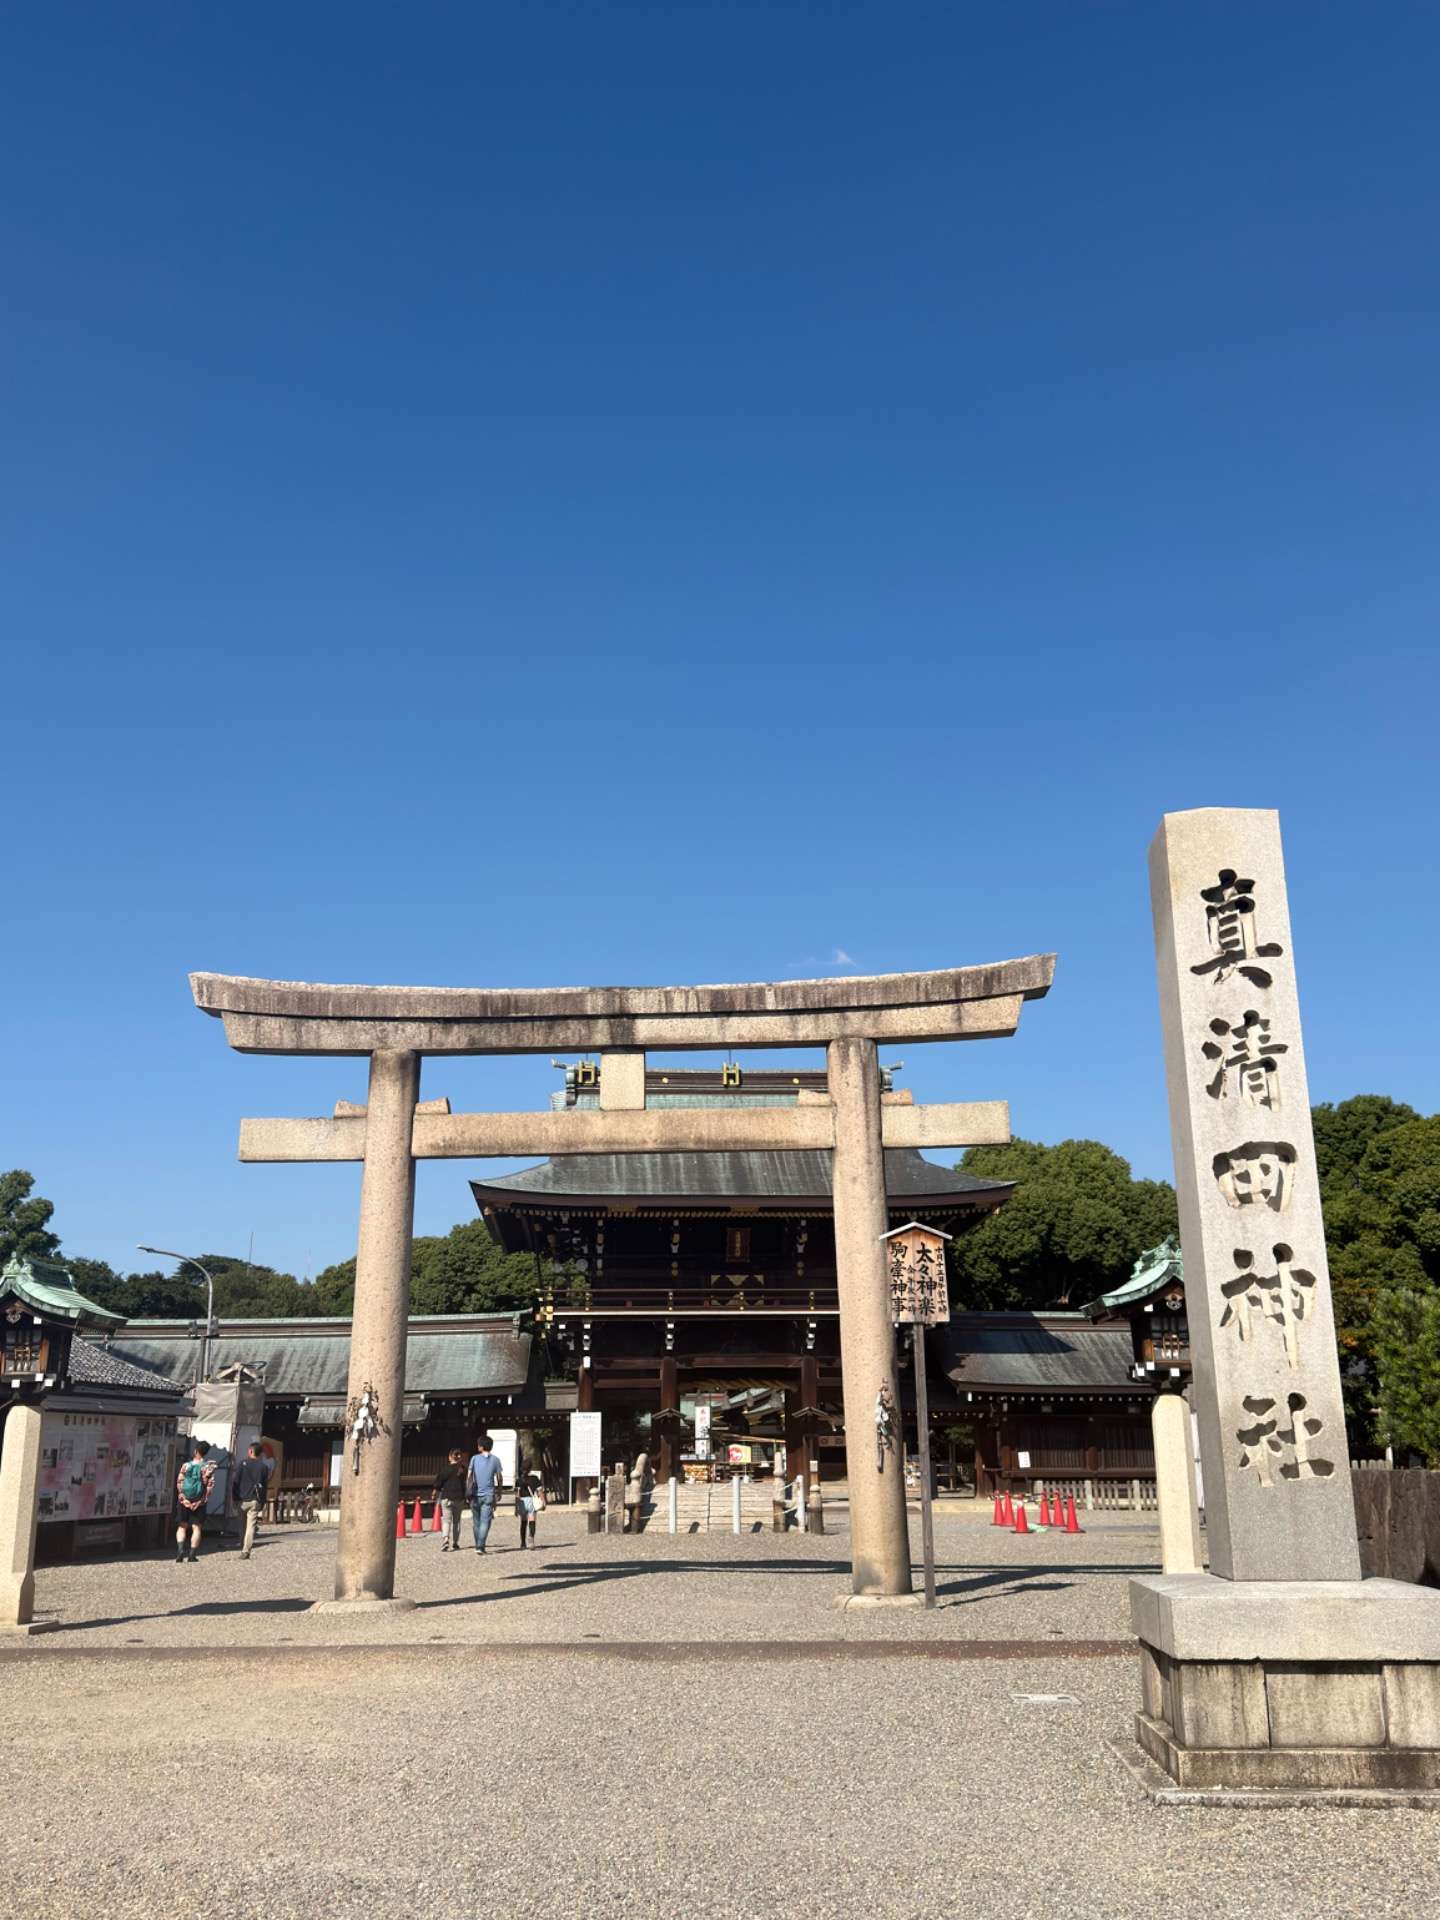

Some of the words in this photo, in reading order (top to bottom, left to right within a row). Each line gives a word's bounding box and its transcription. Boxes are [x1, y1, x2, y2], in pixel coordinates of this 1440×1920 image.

[916, 1241, 938, 1316] 太々神楽
[1191, 868, 1336, 1488] 真清田神社
